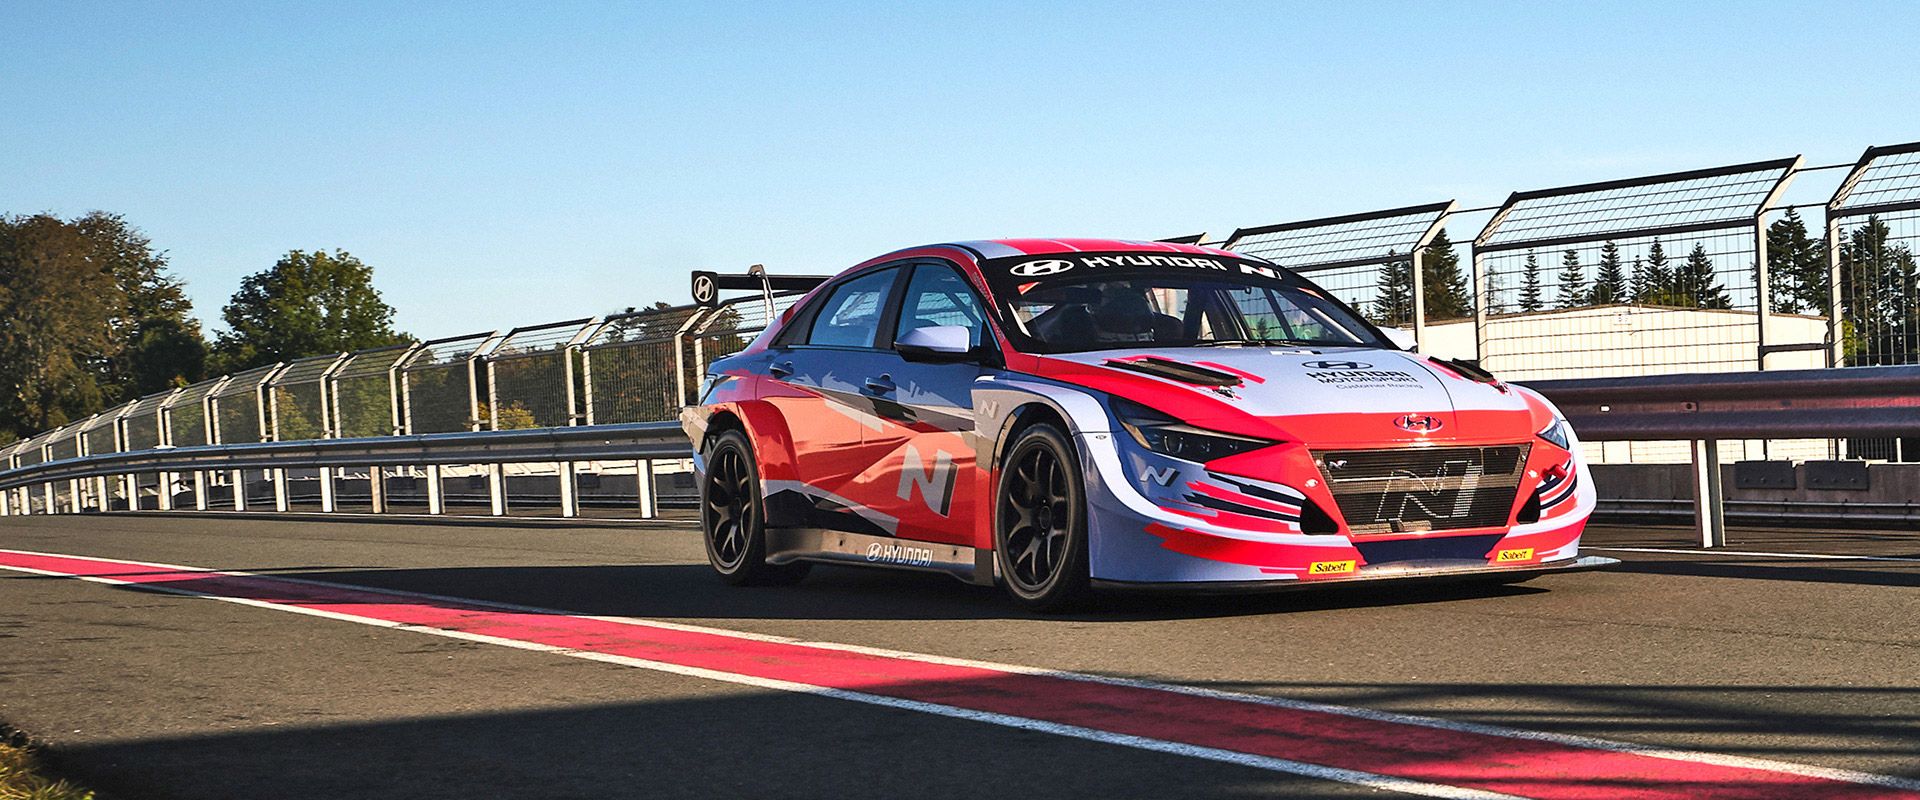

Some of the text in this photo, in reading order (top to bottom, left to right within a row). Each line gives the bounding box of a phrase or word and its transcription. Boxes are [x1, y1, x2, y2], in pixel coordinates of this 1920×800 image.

[1080, 255, 1228, 271] HYUNDAI
[897, 443, 959, 519] N
[882, 544, 933, 567] HYUNDAI
